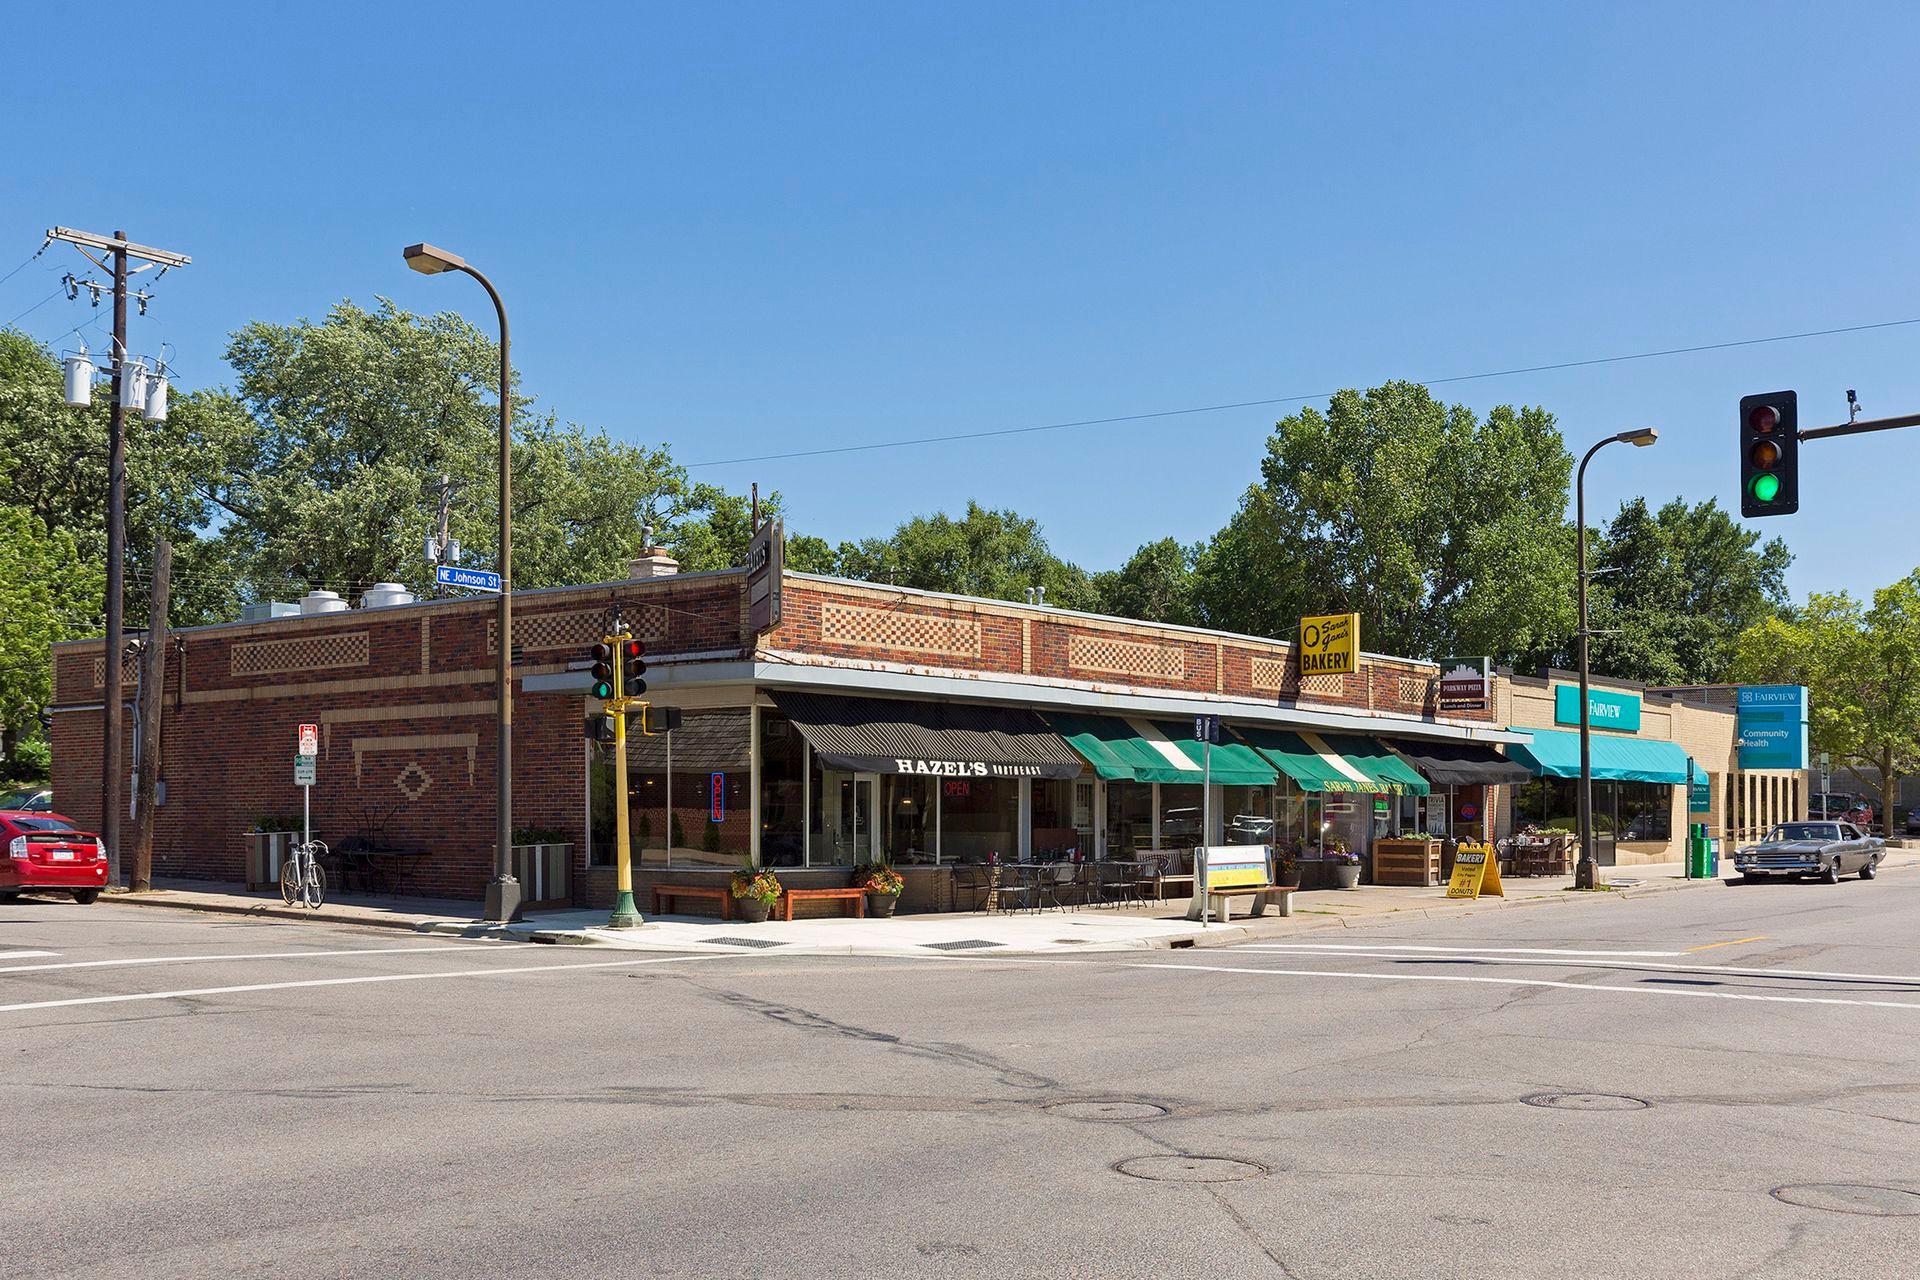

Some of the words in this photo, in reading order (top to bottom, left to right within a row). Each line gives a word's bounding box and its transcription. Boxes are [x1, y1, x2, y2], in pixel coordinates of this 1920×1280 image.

[440, 569, 450, 581] NE
[453, 571, 486, 586] Johnson
[488, 575, 497, 587] St
[1321, 617, 1349, 634] Sarah
[1303, 652, 1349, 671] BAKERY
[1443, 684, 1468, 692] PARKWAY
[1755, 692, 1797, 701] FAIRVIEW
[1590, 699, 1622, 719] FAIRVIEW
[1743, 729, 1789, 739] Community
[1743, 739, 1769, 747] Health
[895, 759, 989, 776] HAZEL'S
[945, 782, 970, 796] OPEN
[1323, 780, 1353, 792] SARAH
[713, 775, 722, 819] OPEN
[1456, 853, 1485, 864] BAKERY
[1459, 879, 1471, 888] #1
